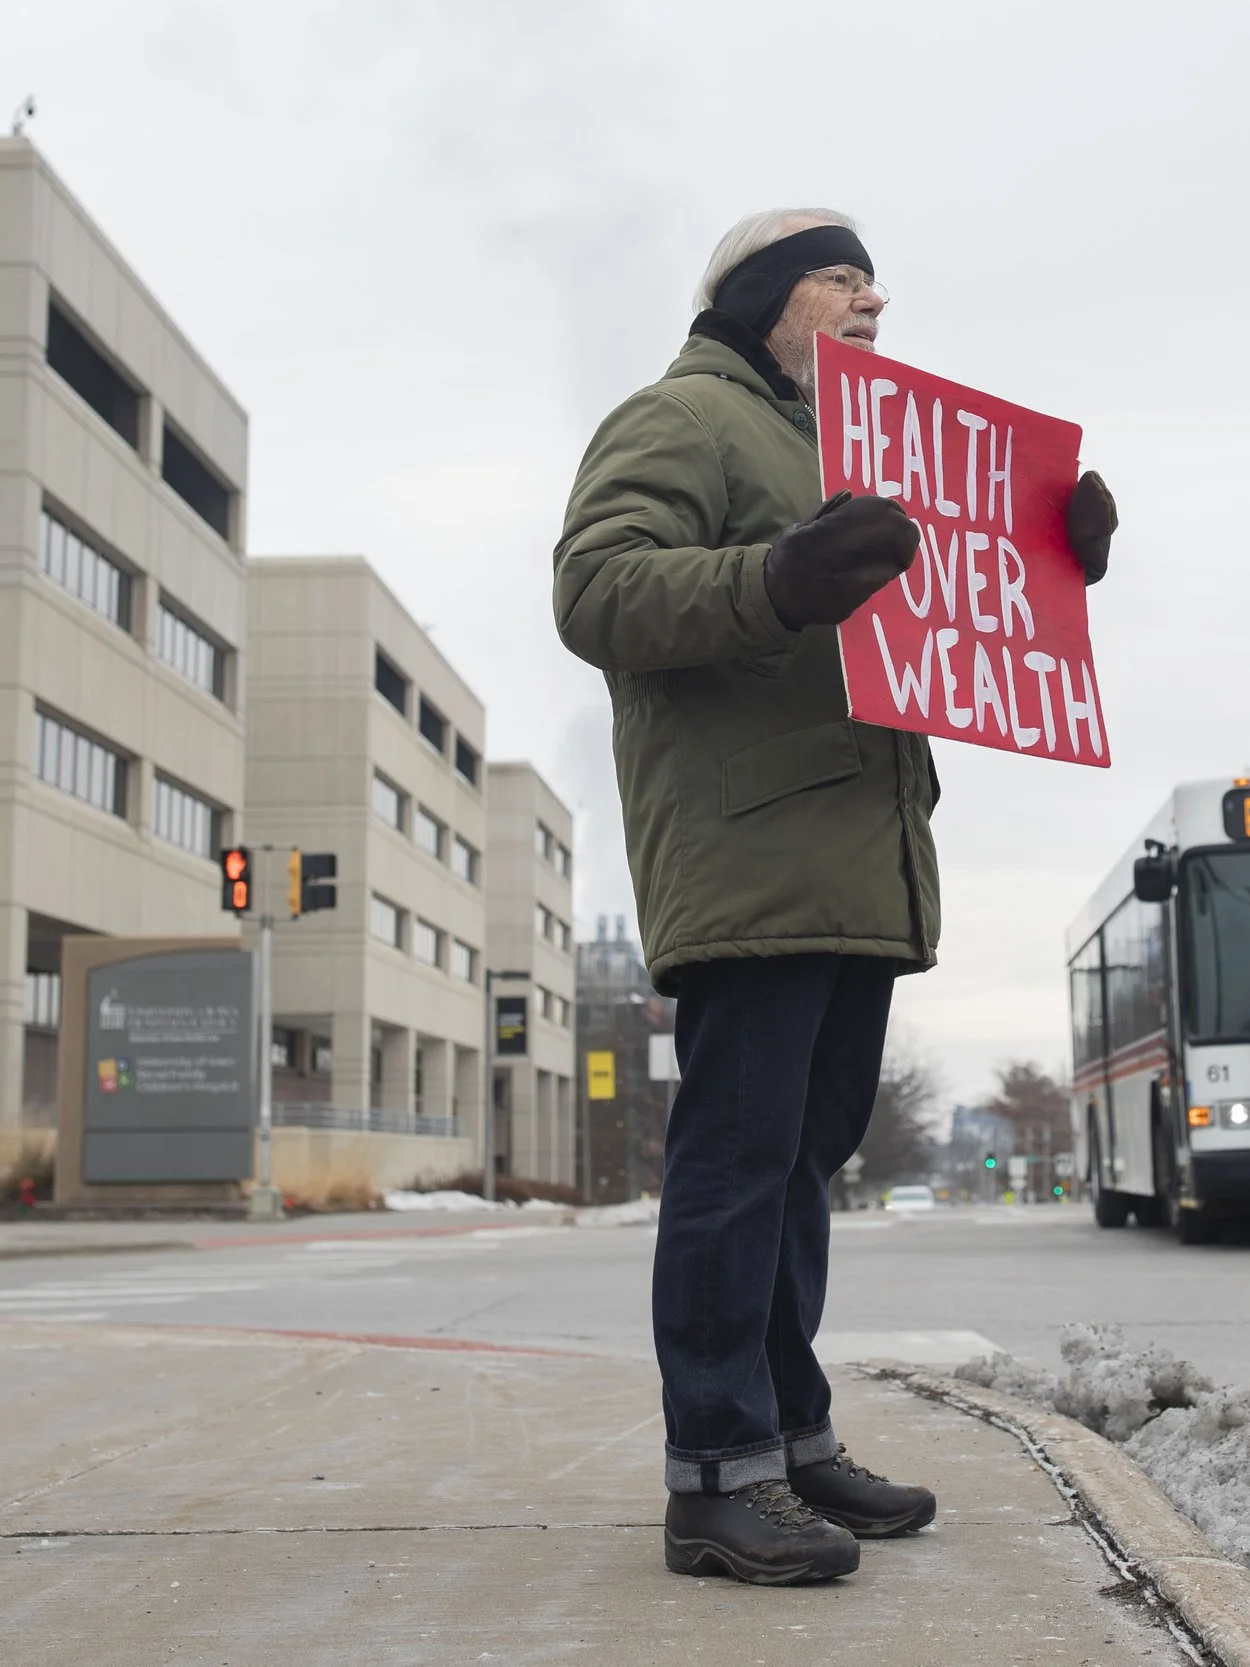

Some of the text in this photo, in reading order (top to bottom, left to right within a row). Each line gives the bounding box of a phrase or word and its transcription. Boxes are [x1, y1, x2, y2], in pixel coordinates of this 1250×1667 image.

[840, 372, 1014, 535] HEALTH
[900, 519, 1035, 641] OVER
[872, 613, 1103, 759] WEALTH
[1207, 1064, 1230, 1083] 61
